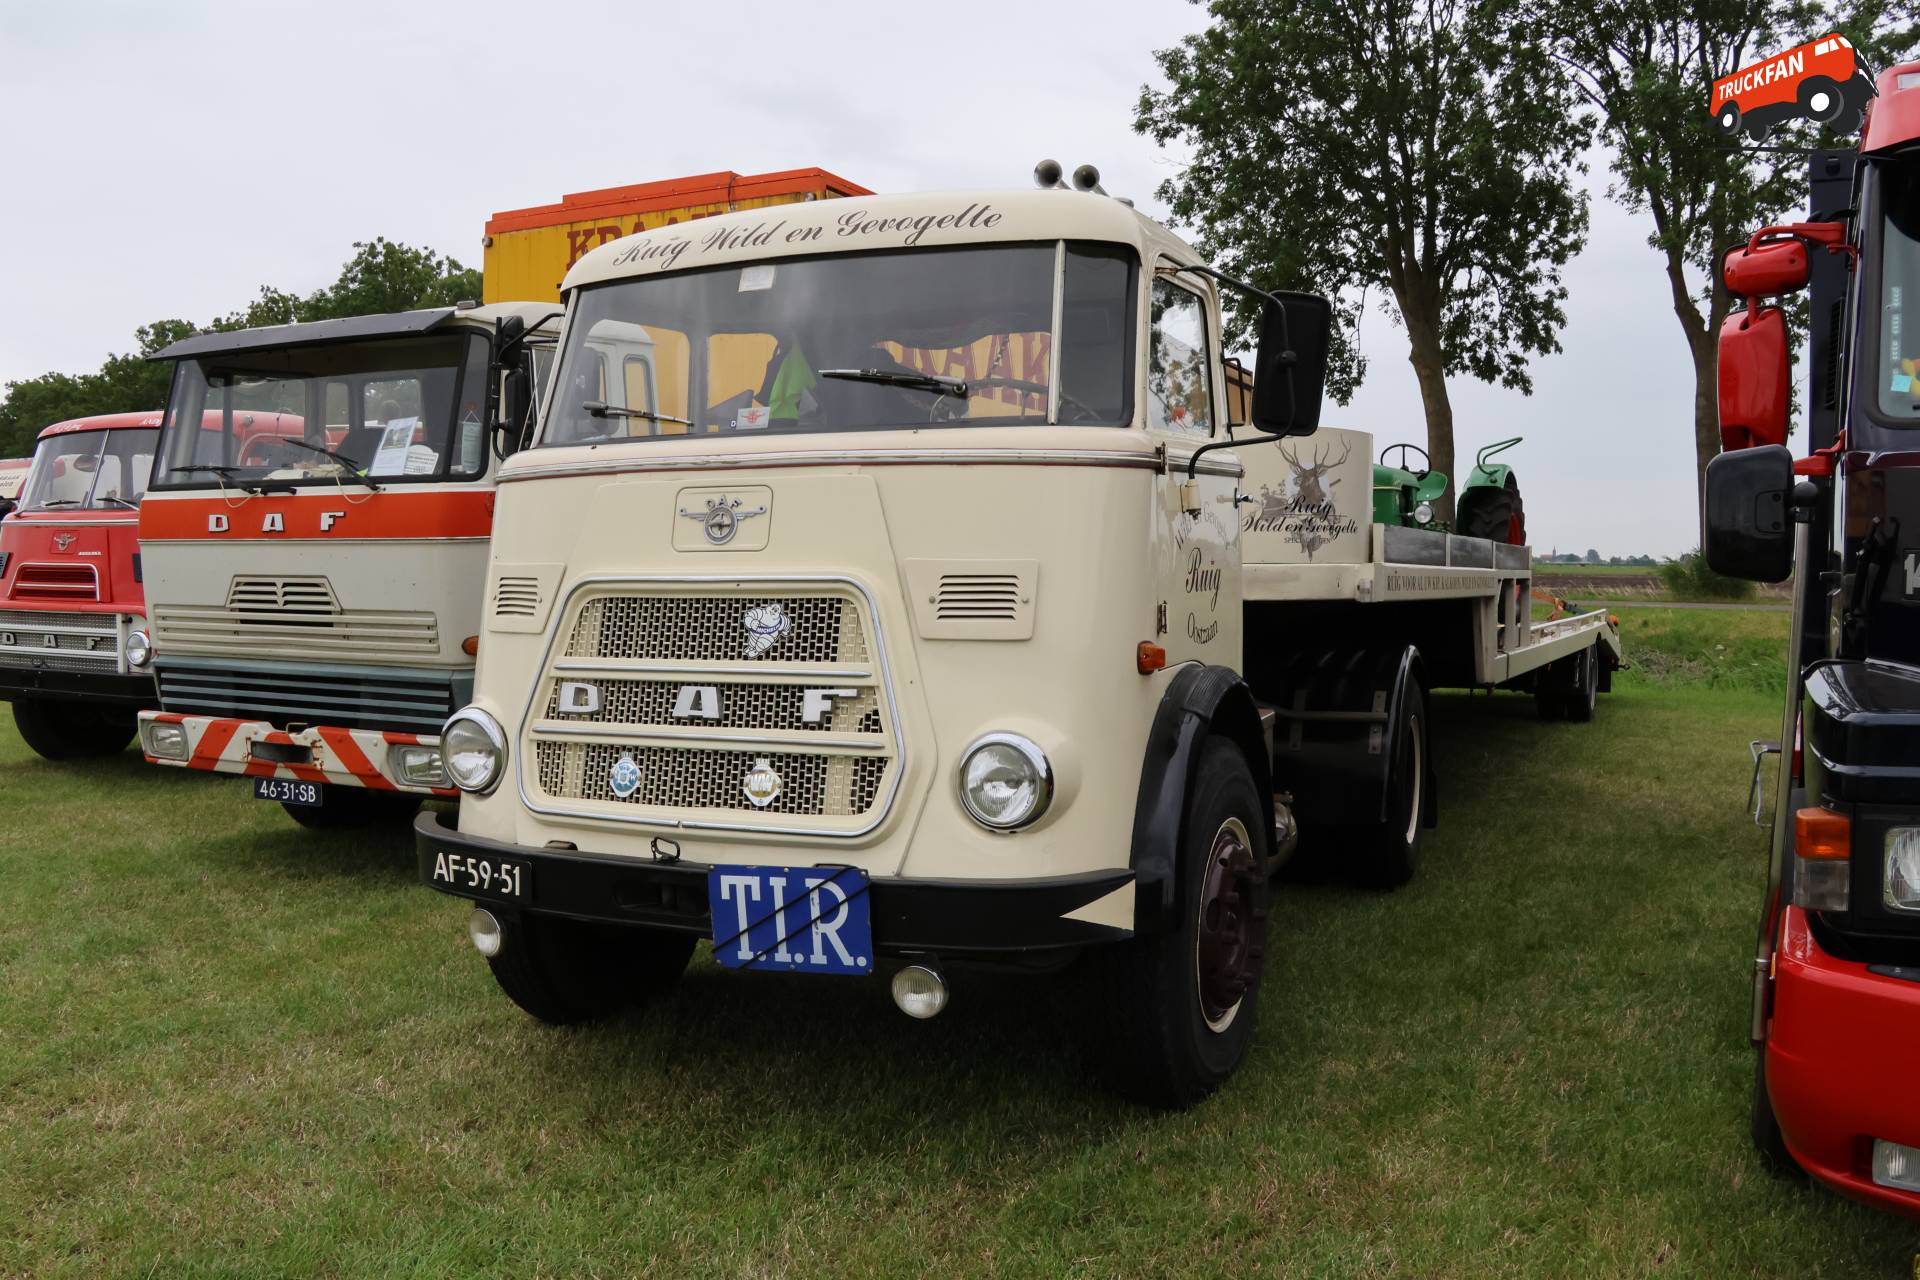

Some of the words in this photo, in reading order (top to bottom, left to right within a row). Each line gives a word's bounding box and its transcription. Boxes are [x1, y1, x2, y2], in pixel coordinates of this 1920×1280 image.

[612, 236, 691, 270] Ruig
[701, 219, 787, 253] Wild
[785, 225, 824, 244] en
[837, 203, 1003, 247] Gevogelte
[208, 511, 346, 533] DAF
[1242, 515, 1287, 533] Wild
[1285, 522, 1303, 533] en
[1284, 494, 1333, 522] Ruig
[1185, 547, 1222, 612] Ruig
[1, 631, 103, 651] DAF
[557, 682, 857, 725] DAF
[259, 780, 317, 803] 46-31-SB
[433, 852, 521, 897] AF-59-51
[719, 873, 867, 968] T.I.R.
